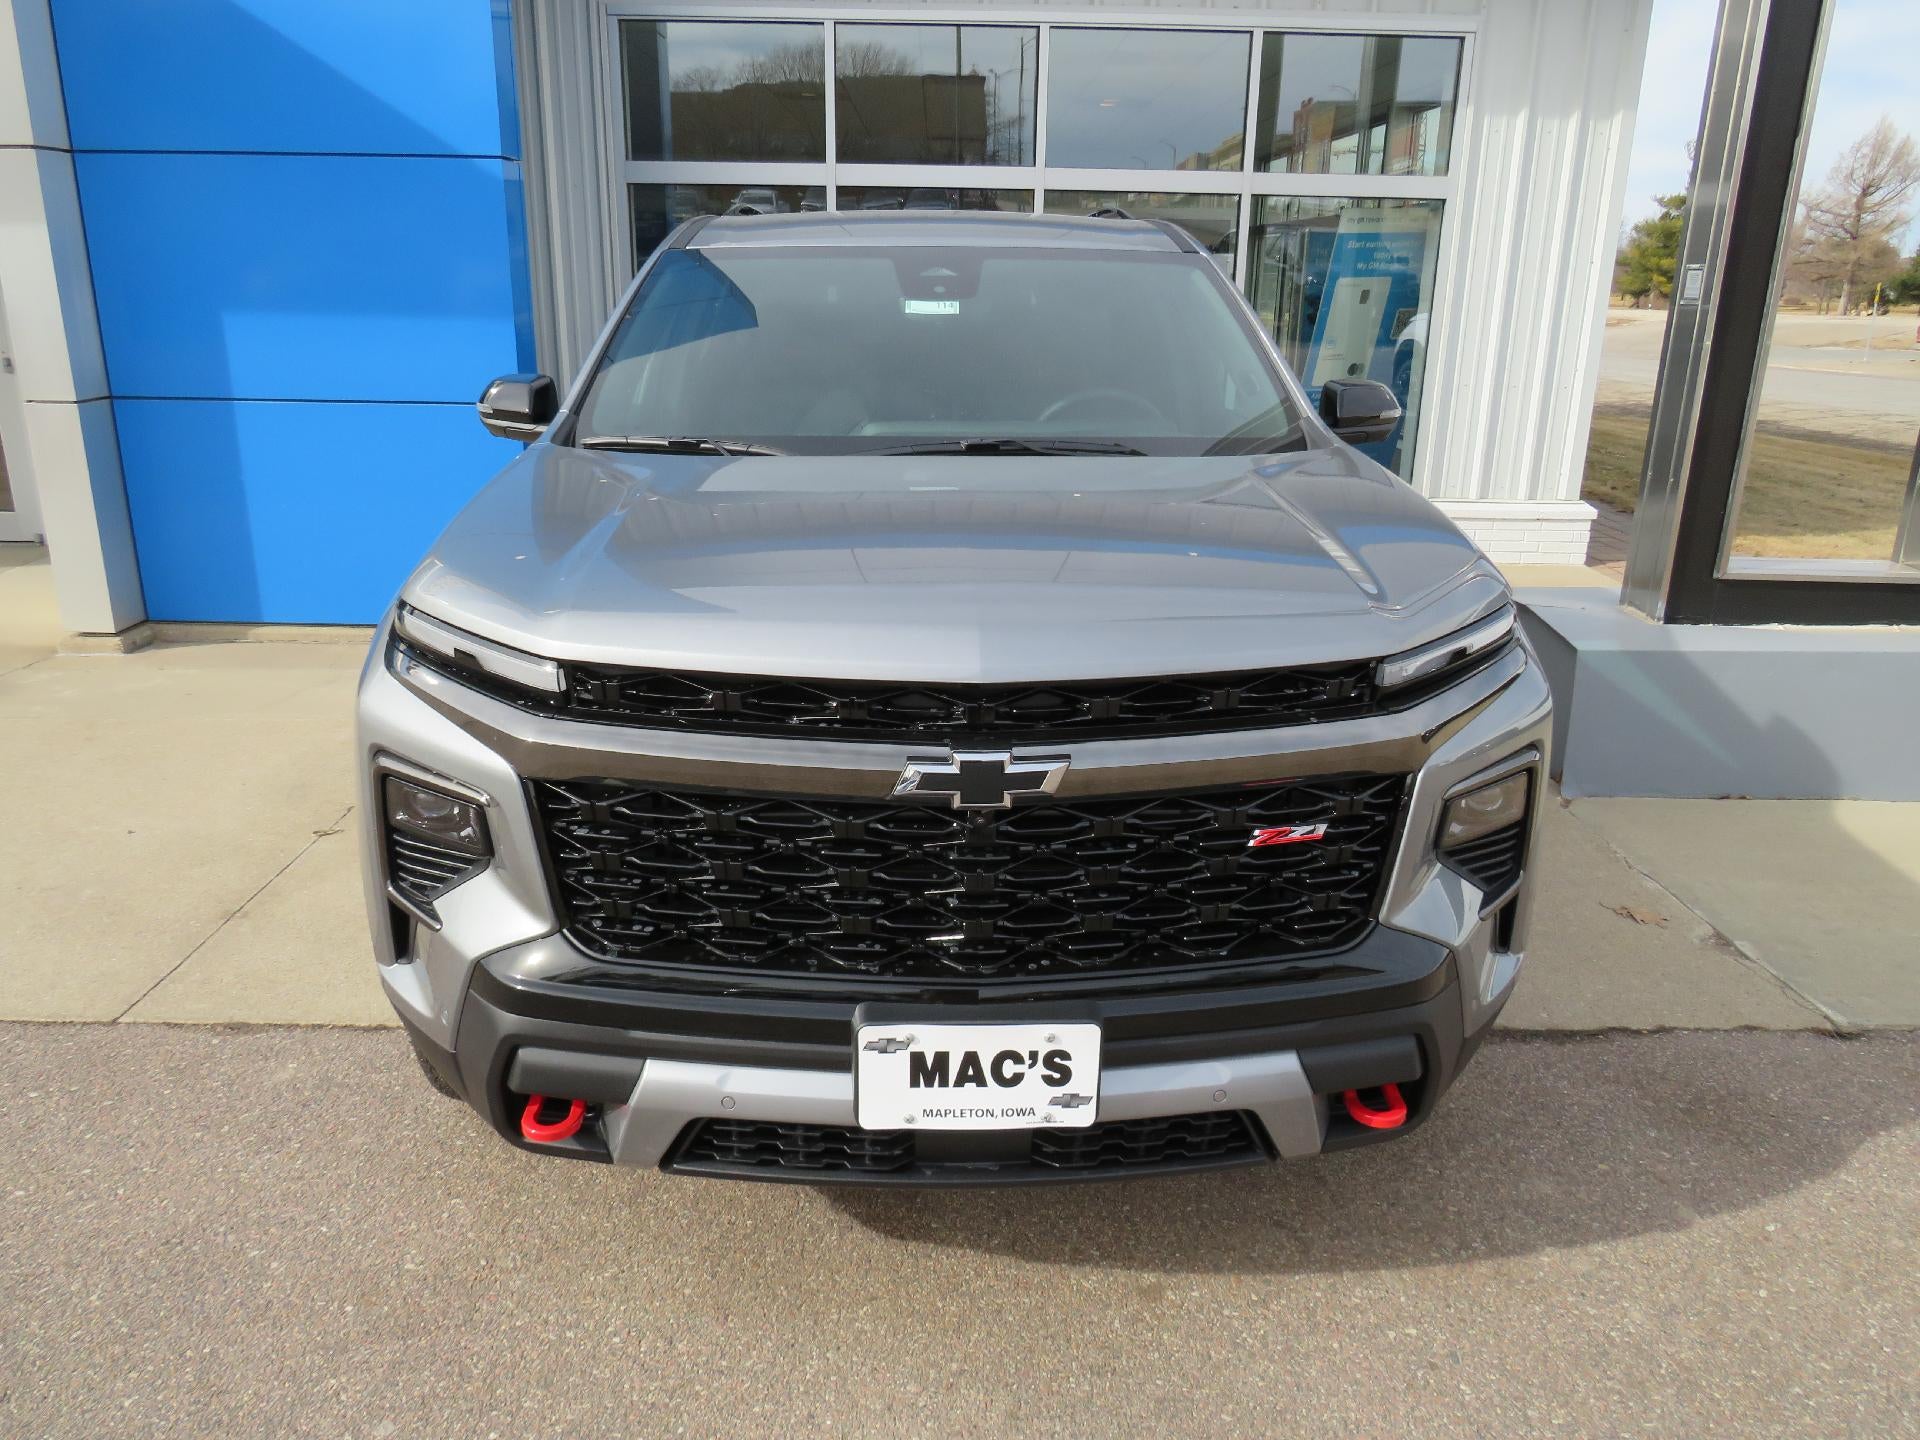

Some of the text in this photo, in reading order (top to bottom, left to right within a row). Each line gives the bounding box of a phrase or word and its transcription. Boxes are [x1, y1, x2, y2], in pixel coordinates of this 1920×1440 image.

[1347, 240, 1365, 248] Start
[1247, 823, 1328, 847] Z71
[909, 1049, 1073, 1089] MAC'S
[922, 1107, 1036, 1119] MAPLETON, IOWA
